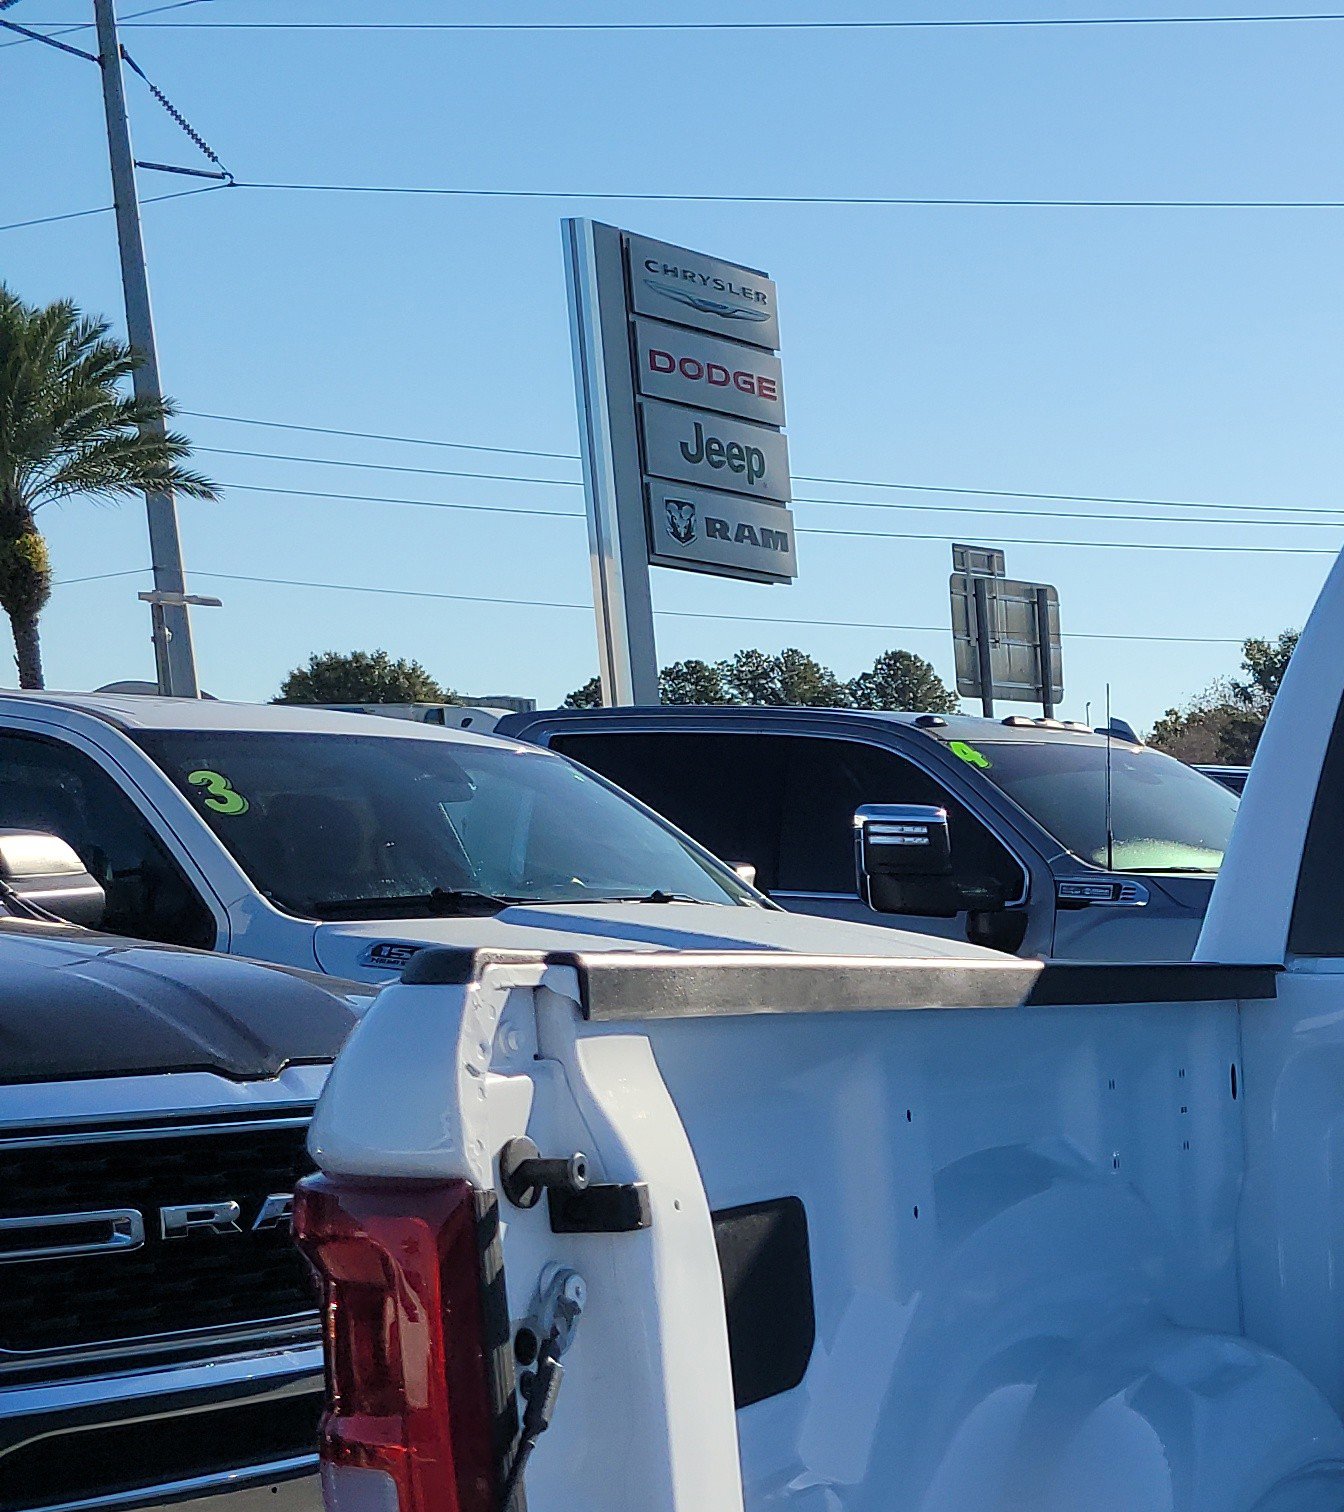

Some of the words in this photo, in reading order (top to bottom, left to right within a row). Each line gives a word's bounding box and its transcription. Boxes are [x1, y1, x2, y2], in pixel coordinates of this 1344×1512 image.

[644, 259, 768, 305] CHRYSLER
[649, 349, 778, 401] DODGE
[680, 422, 765, 484] Jeep
[704, 516, 789, 553] RAM
[188, 770, 249, 815] 3
[160, 1193, 295, 1240] RA
